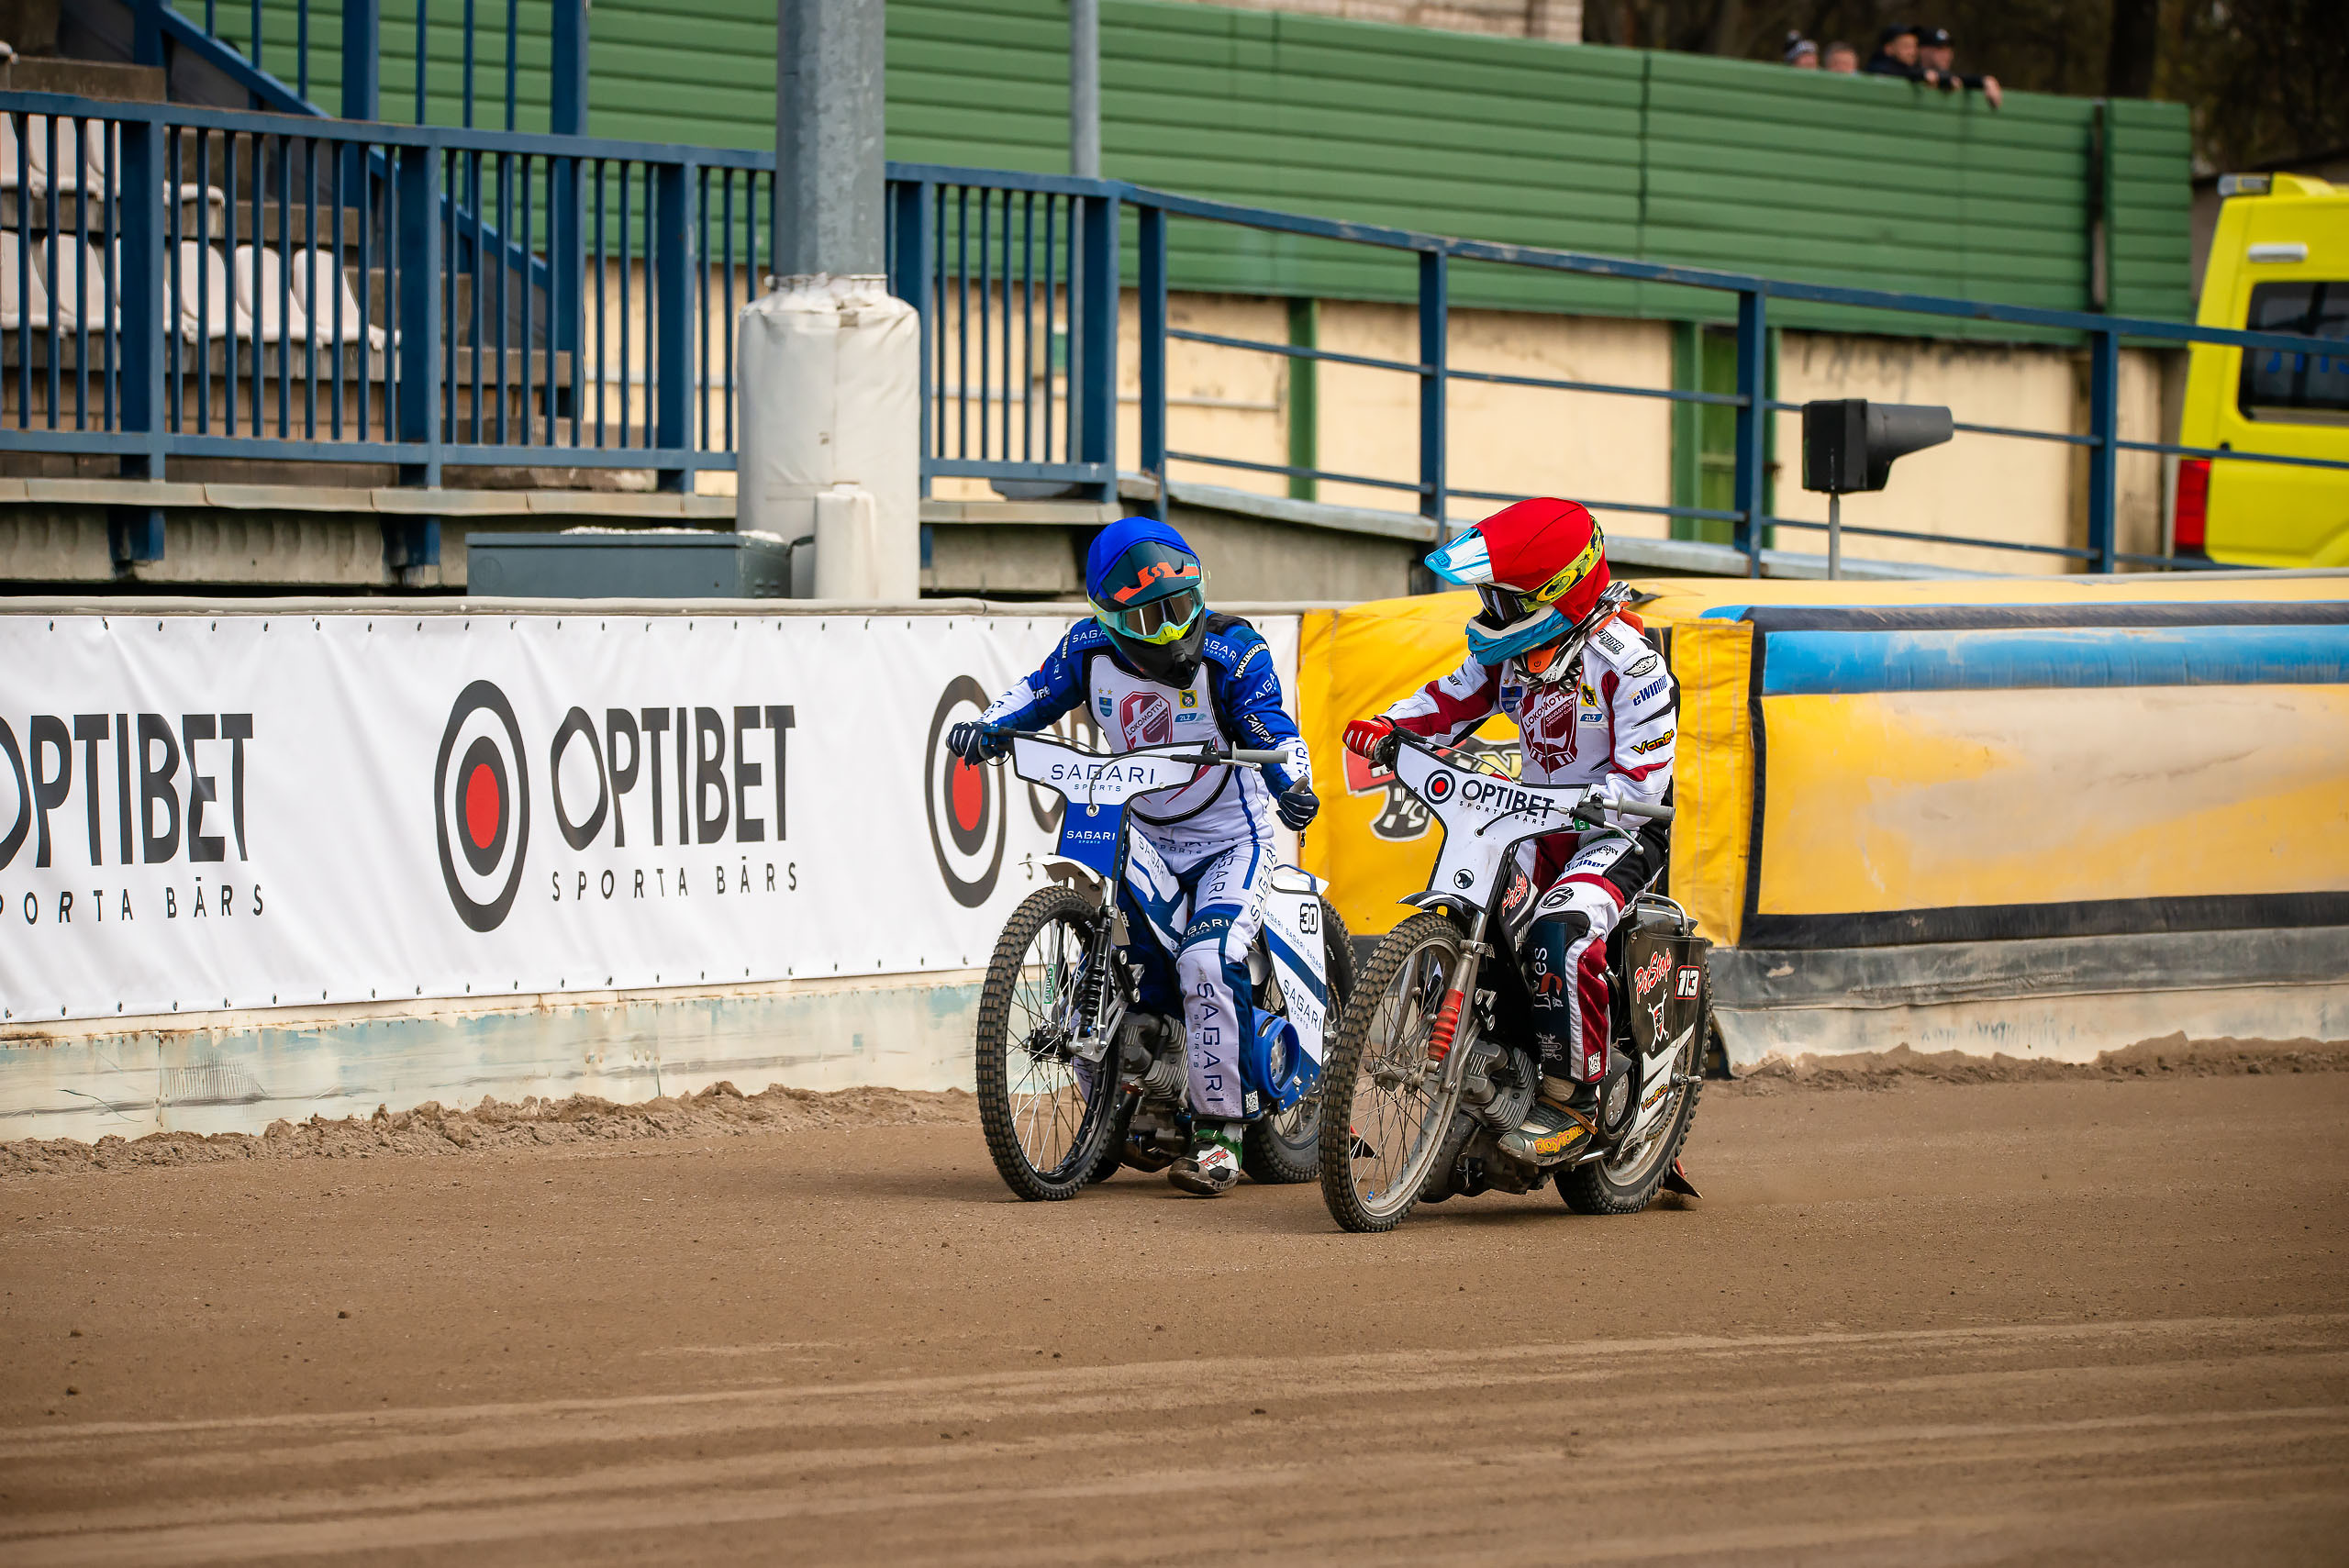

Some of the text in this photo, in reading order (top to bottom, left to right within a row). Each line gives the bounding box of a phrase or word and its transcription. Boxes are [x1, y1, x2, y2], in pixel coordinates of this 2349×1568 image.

[1204, 639, 1238, 663] AGARI
[1126, 700, 1164, 736] LOKOMOTIV
[1524, 694, 1570, 728] LOKOMOT
[550, 705, 796, 851] OPTIBET
[1051, 763, 1154, 784] SAGARI
[1074, 784, 1121, 792] SPORTS
[1459, 800, 1545, 827] SPORTA BĀRS
[1462, 780, 1555, 818] OPTIBET
[1066, 830, 1116, 840] SAGARI
[552, 856, 796, 902] SPORTA BĀRS
[165, 876, 263, 919] BĀRS
[1182, 918, 1230, 940] GARI
[1299, 903, 1319, 934] 30
[1284, 979, 1322, 1032] SAGARI
[1290, 1007, 1308, 1029] SPORTS
[1197, 982, 1224, 1102] SAGARI
